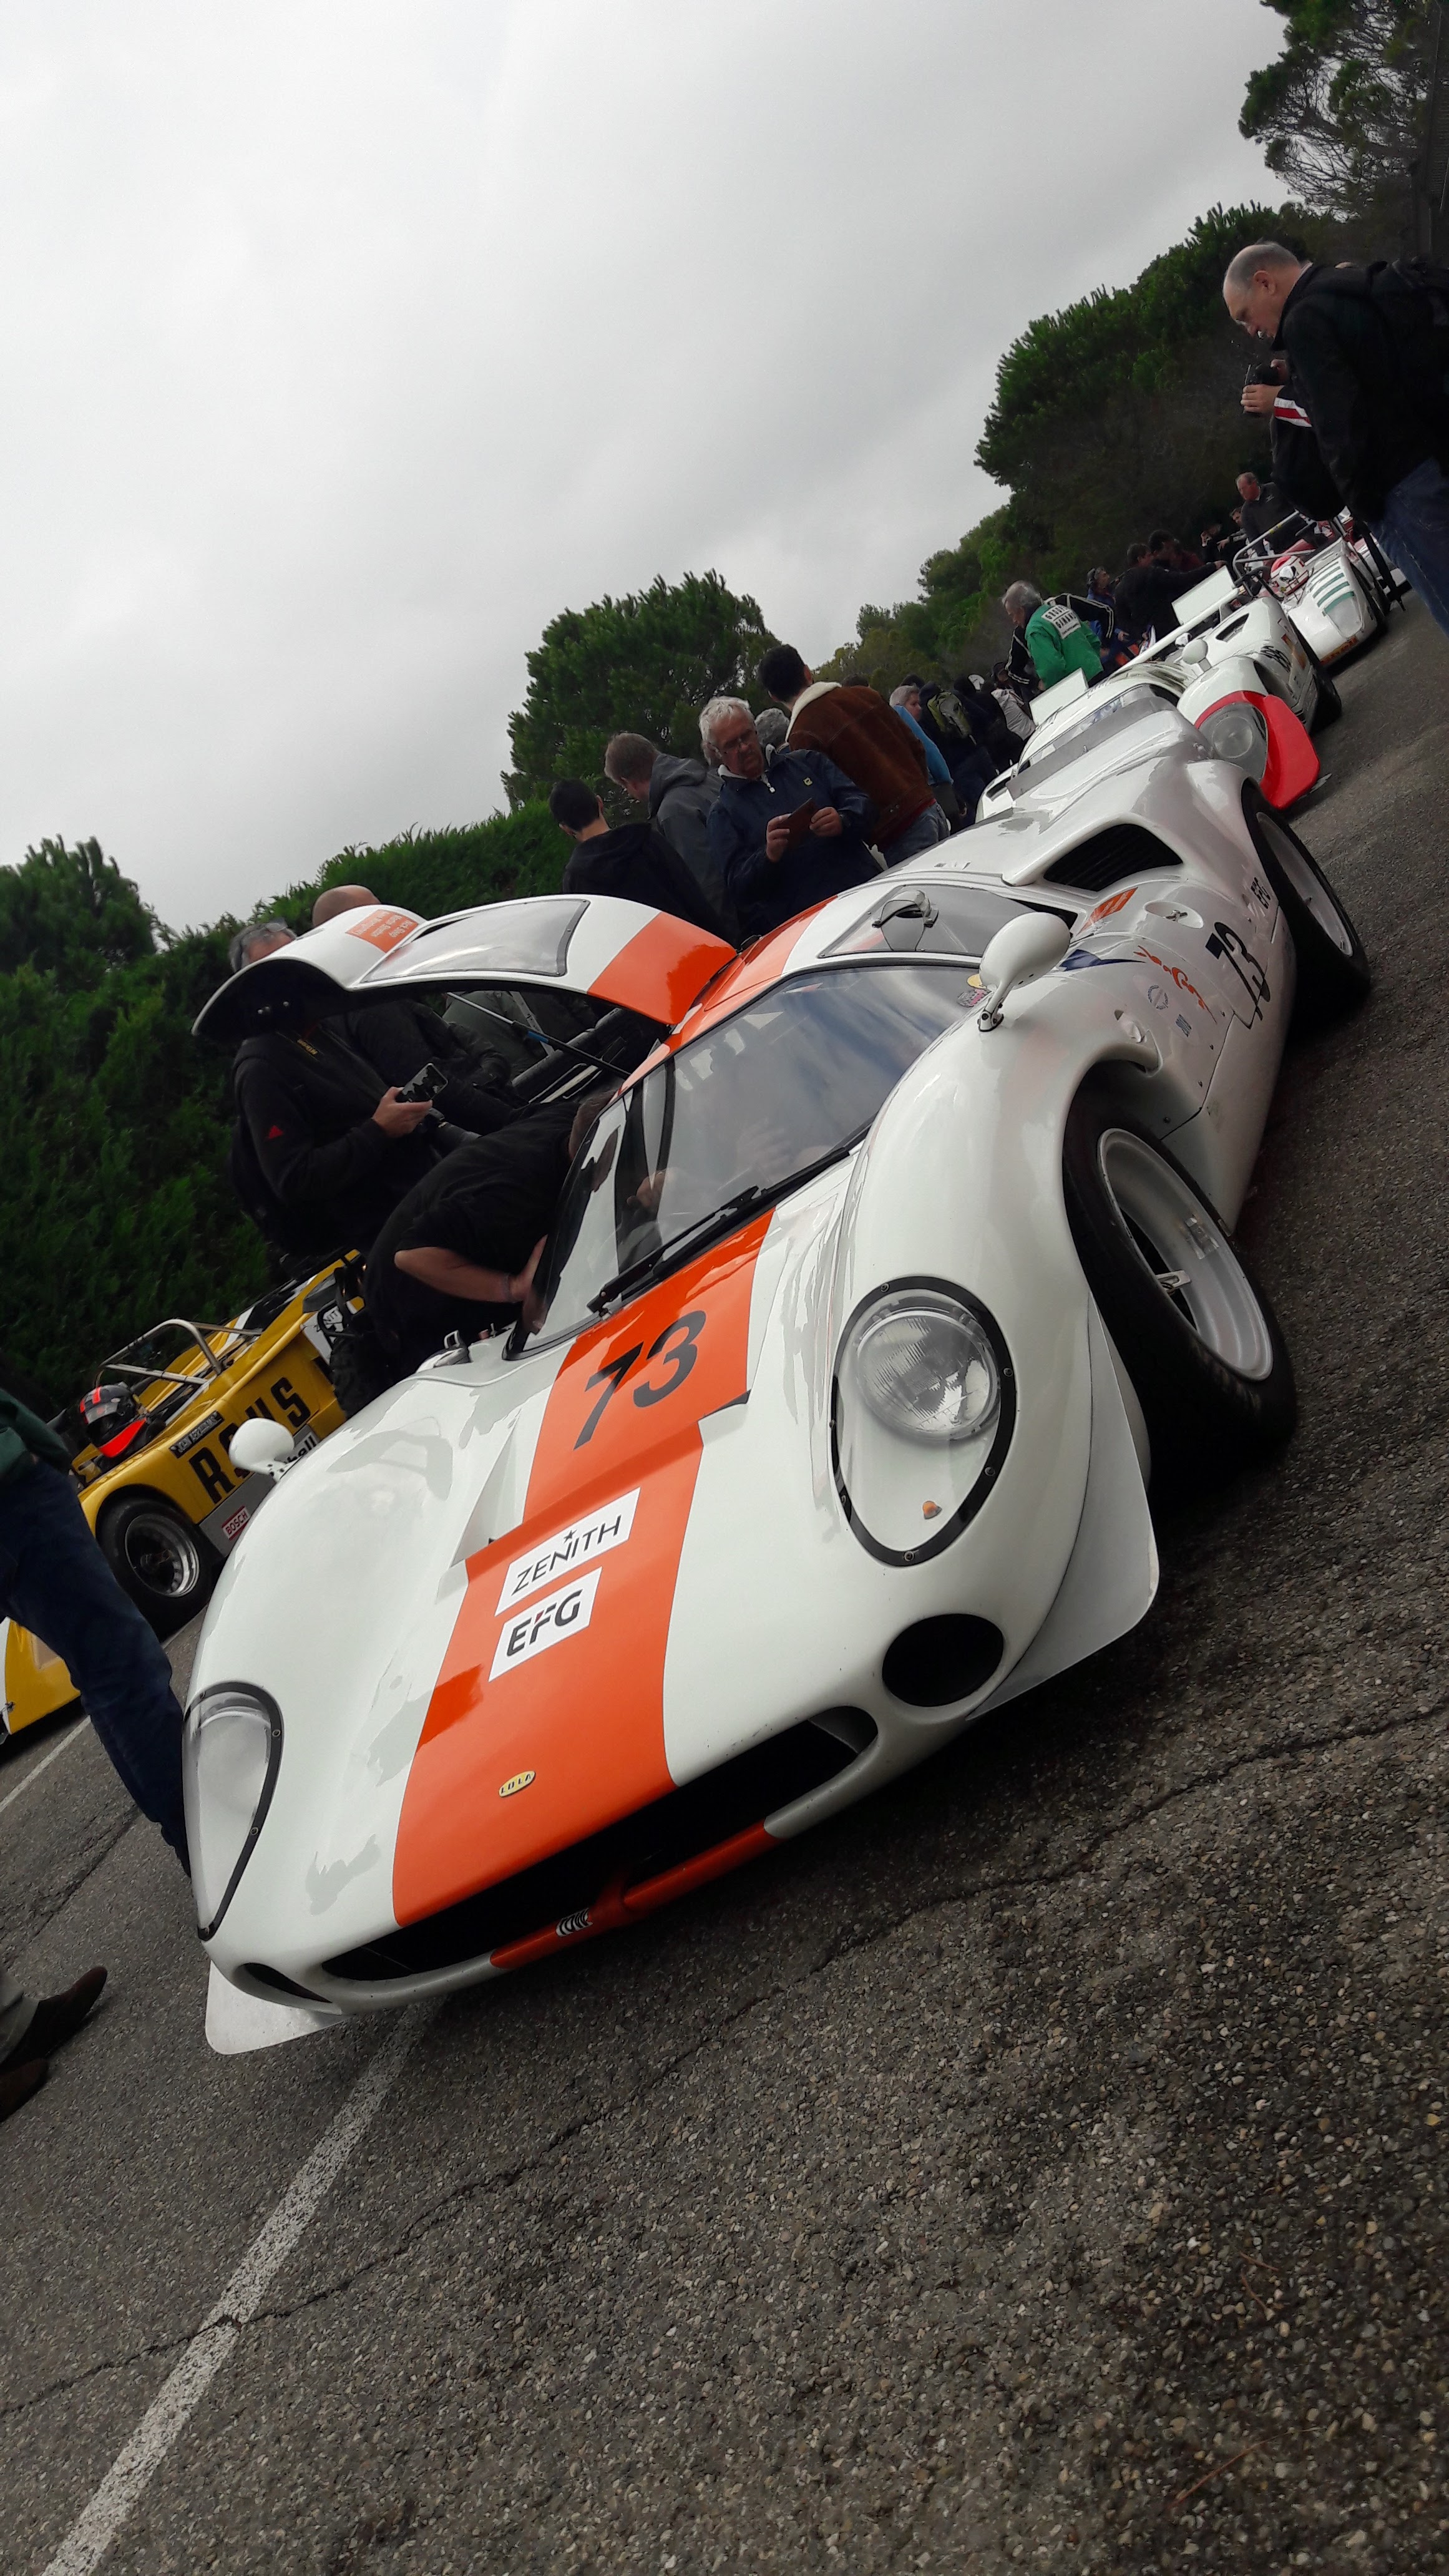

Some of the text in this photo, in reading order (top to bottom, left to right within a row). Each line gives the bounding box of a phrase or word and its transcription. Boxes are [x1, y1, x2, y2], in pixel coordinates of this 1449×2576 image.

[1205, 922, 1271, 1022] 73
[573, 1310, 707, 1451] 73
[284, 1435, 318, 1465] hell
[225, 1510, 249, 1536] BOSCH
[511, 1514, 622, 1596] ZENITH
[507, 1589, 583, 1657] EFG
[500, 1773, 532, 1794] LOLA
